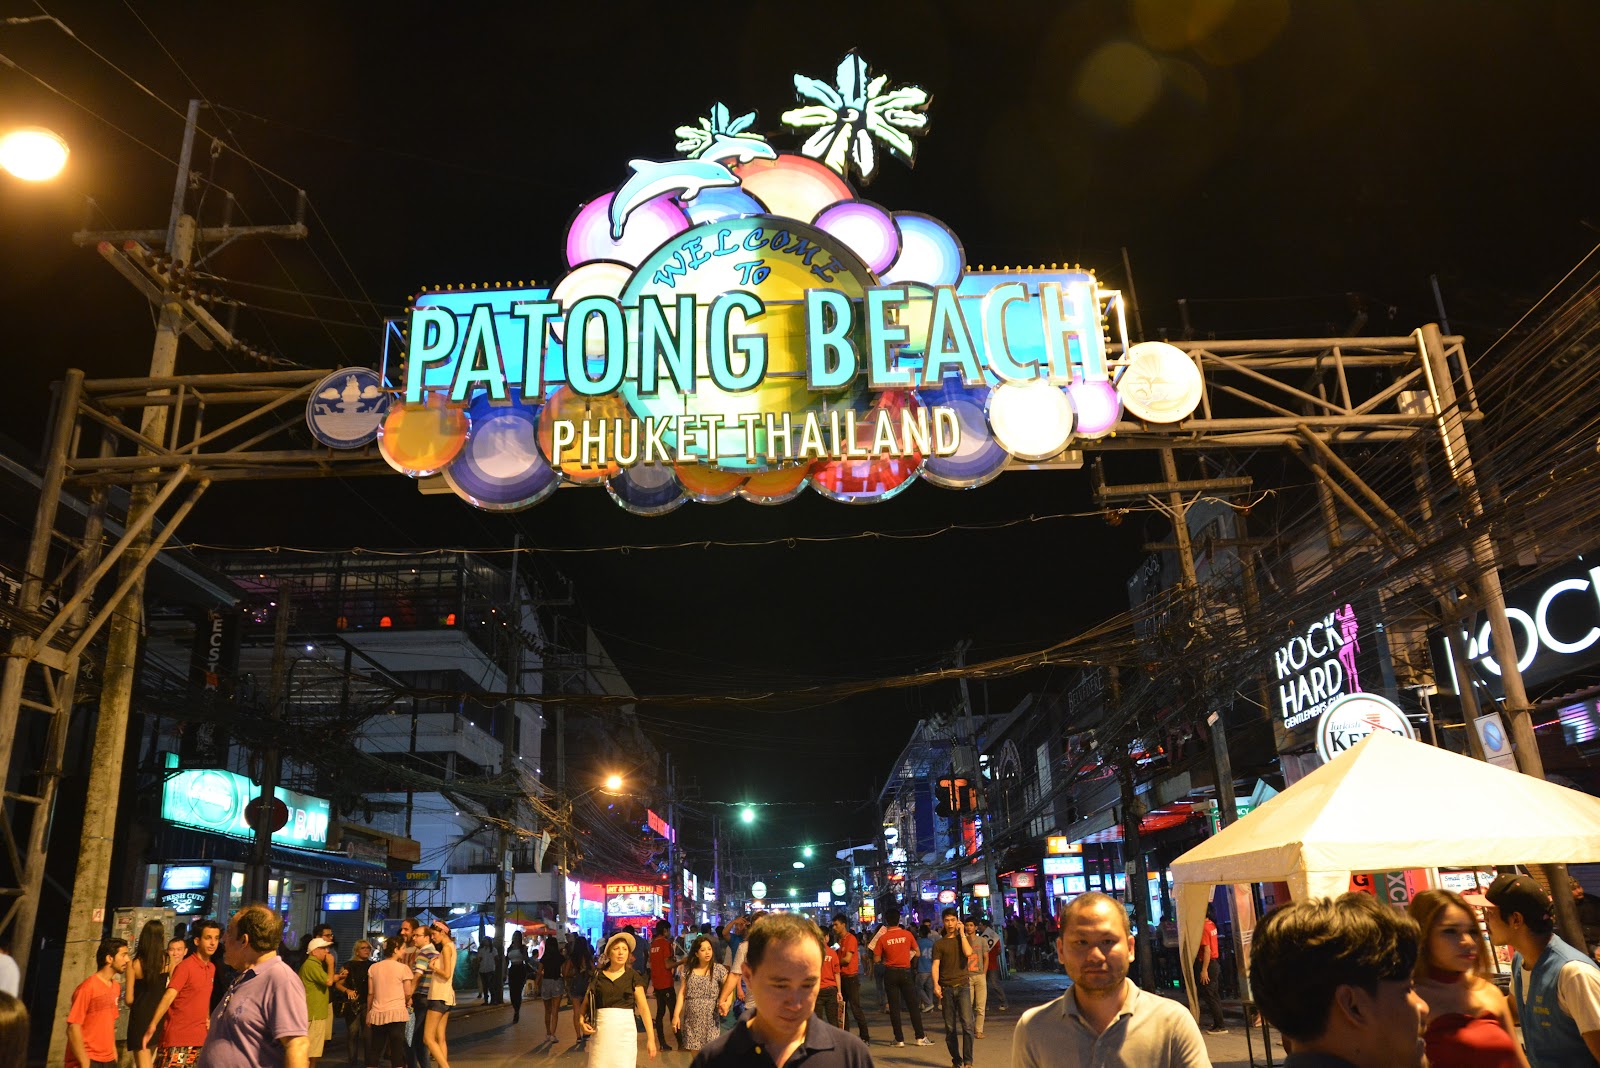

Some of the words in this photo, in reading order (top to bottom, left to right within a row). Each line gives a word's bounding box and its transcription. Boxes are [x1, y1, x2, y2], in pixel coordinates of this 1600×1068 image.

[653, 228, 848, 288] WELCOME
[404, 290, 769, 405] PATONG
[806, 281, 1109, 393] BEACH
[550, 413, 726, 467] PHUKET
[740, 405, 962, 463] THAILAND
[1275, 611, 1345, 680] ROCK
[1279, 658, 1343, 718] HARD
[293, 809, 328, 842] BAR
[162, 893, 186, 902] FRESH
[187, 892, 205, 902] CUTS
[886, 936, 907, 946] STAFF
